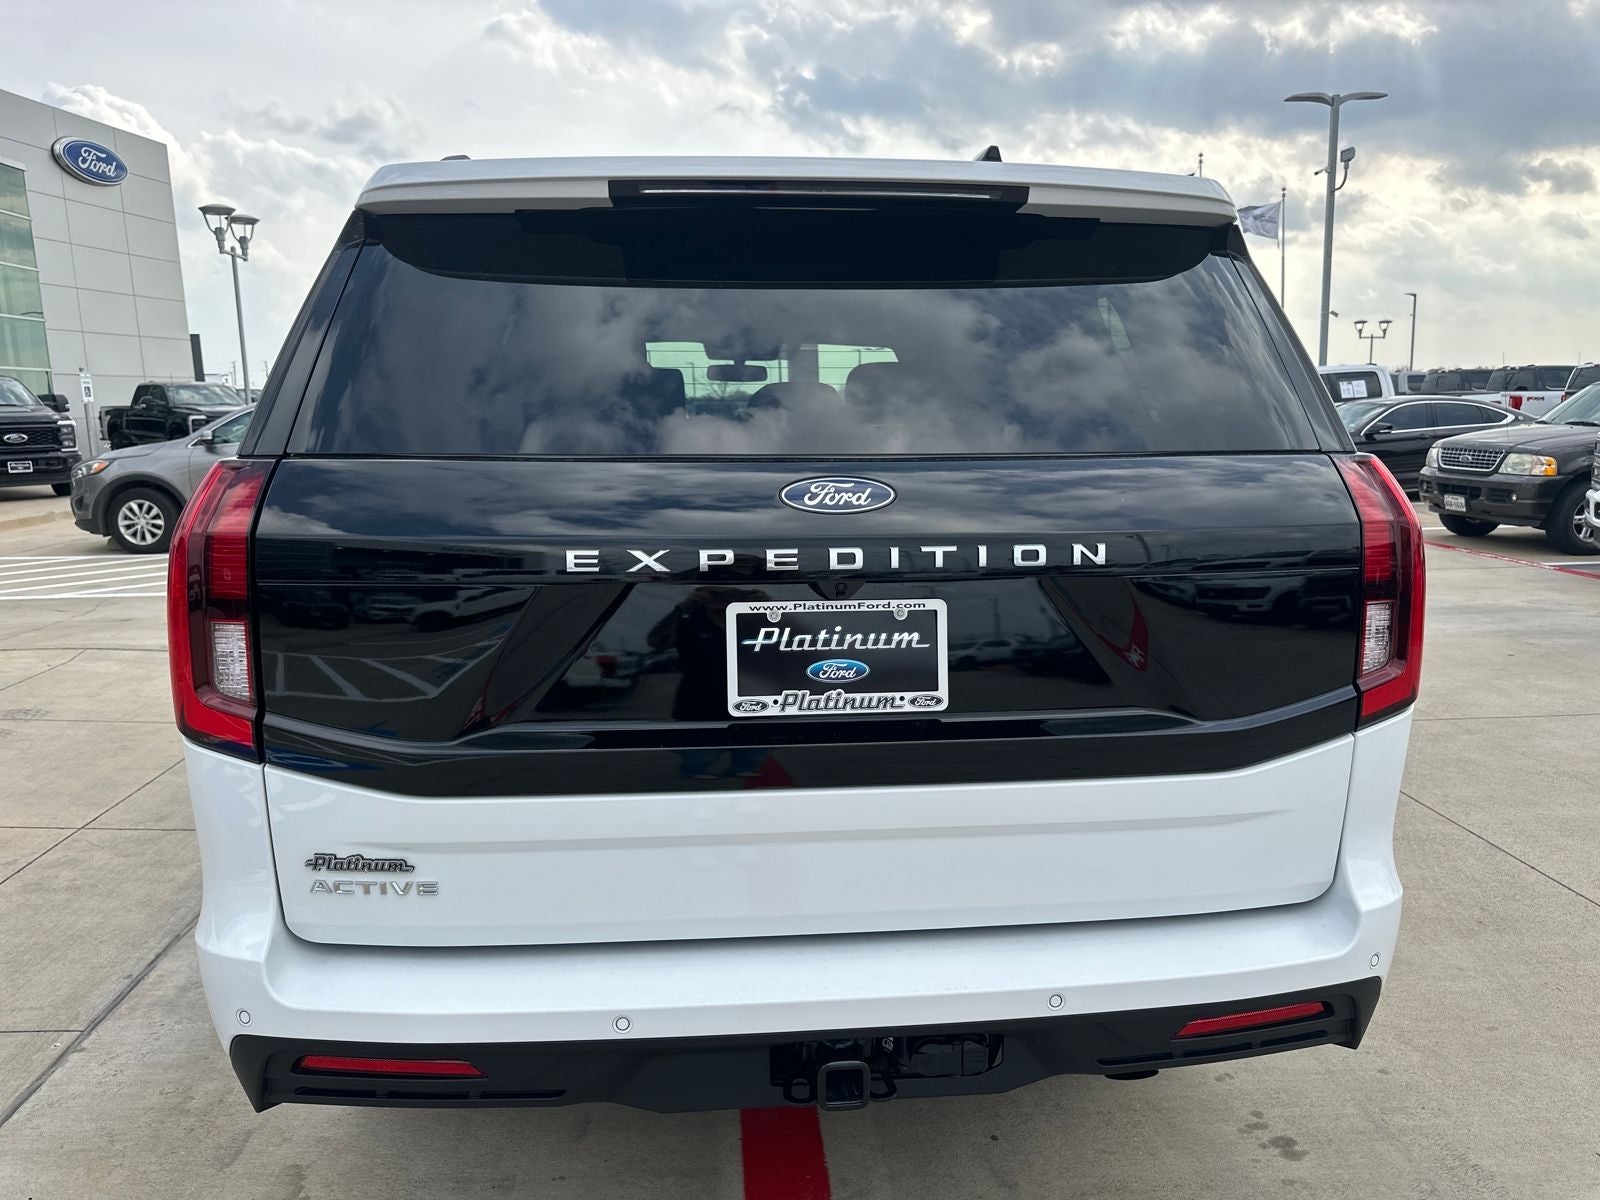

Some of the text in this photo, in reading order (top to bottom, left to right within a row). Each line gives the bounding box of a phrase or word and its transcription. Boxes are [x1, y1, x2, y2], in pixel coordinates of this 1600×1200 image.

[78, 146, 117, 177] Ford
[803, 482, 872, 506] Ford
[565, 543, 1107, 573] EXPEDITION
[749, 601, 926, 612] www.PlatinumFord.com
[741, 625, 931, 652] Platinum
[818, 661, 857, 679] Ford
[739, 689, 937, 712] Ford Platinum Ford
[305, 853, 415, 873] Platinum
[309, 879, 439, 896] ACTIVE
